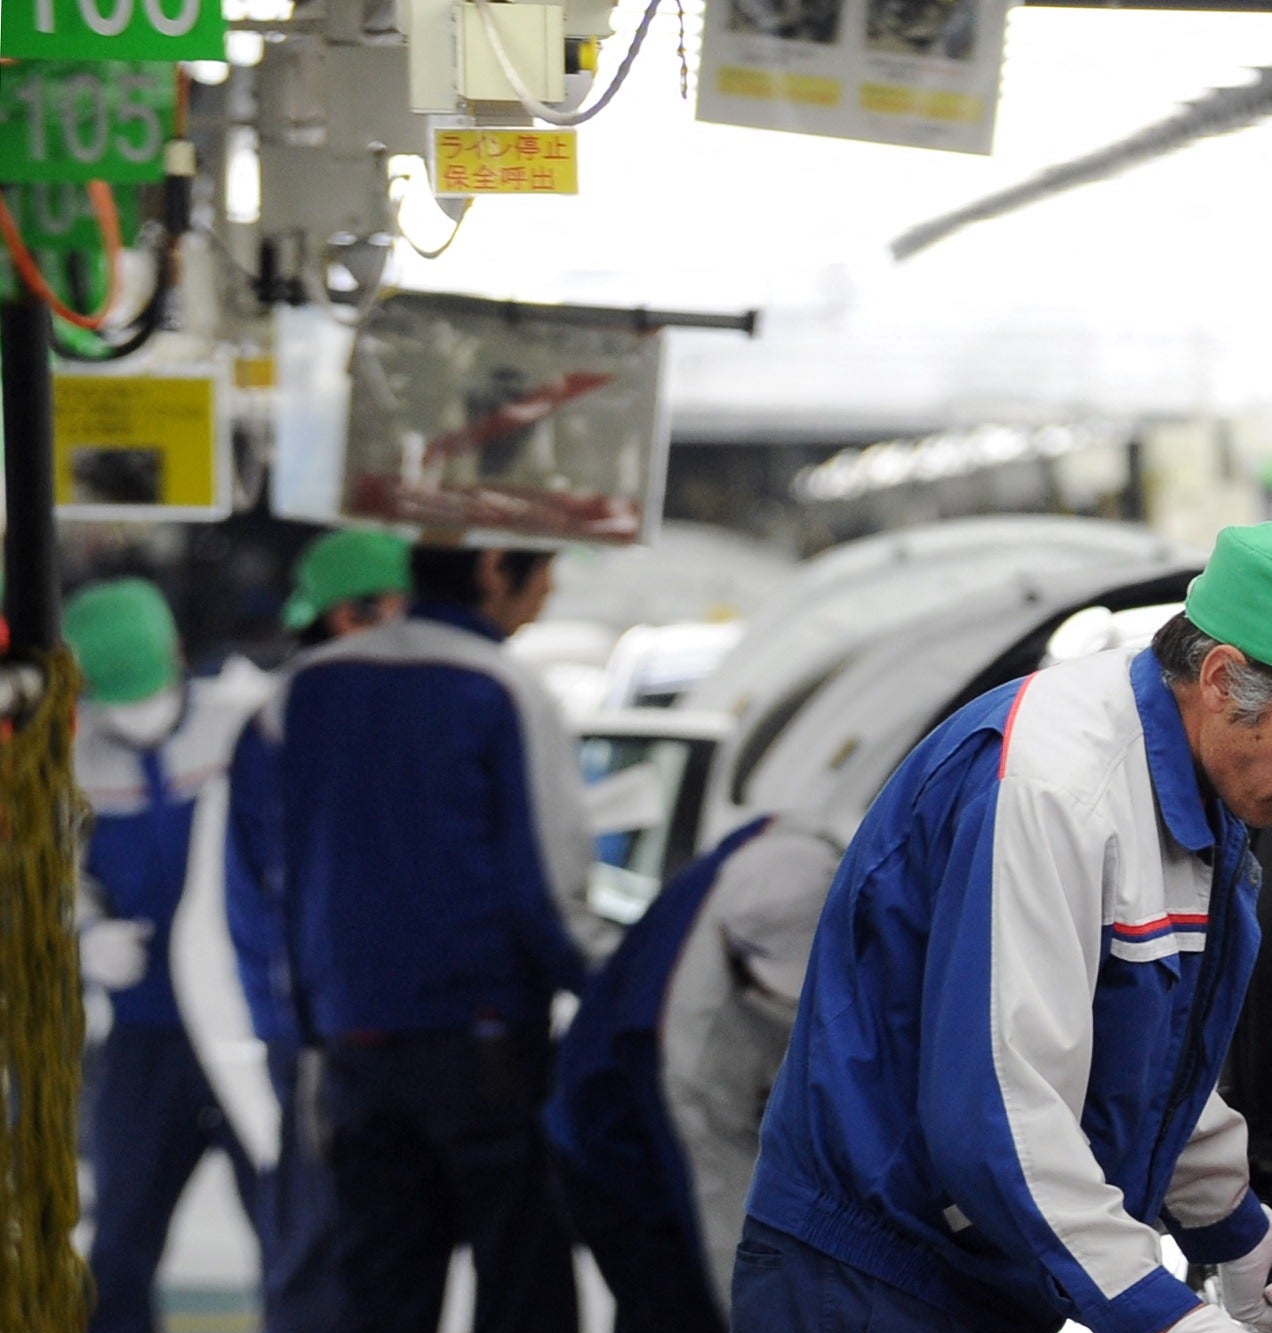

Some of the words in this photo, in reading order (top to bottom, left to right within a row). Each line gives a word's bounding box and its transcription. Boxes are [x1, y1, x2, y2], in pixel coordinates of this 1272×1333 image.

[440, 134, 570, 161] ライン停止
[443, 163, 556, 191] 保全呼出
